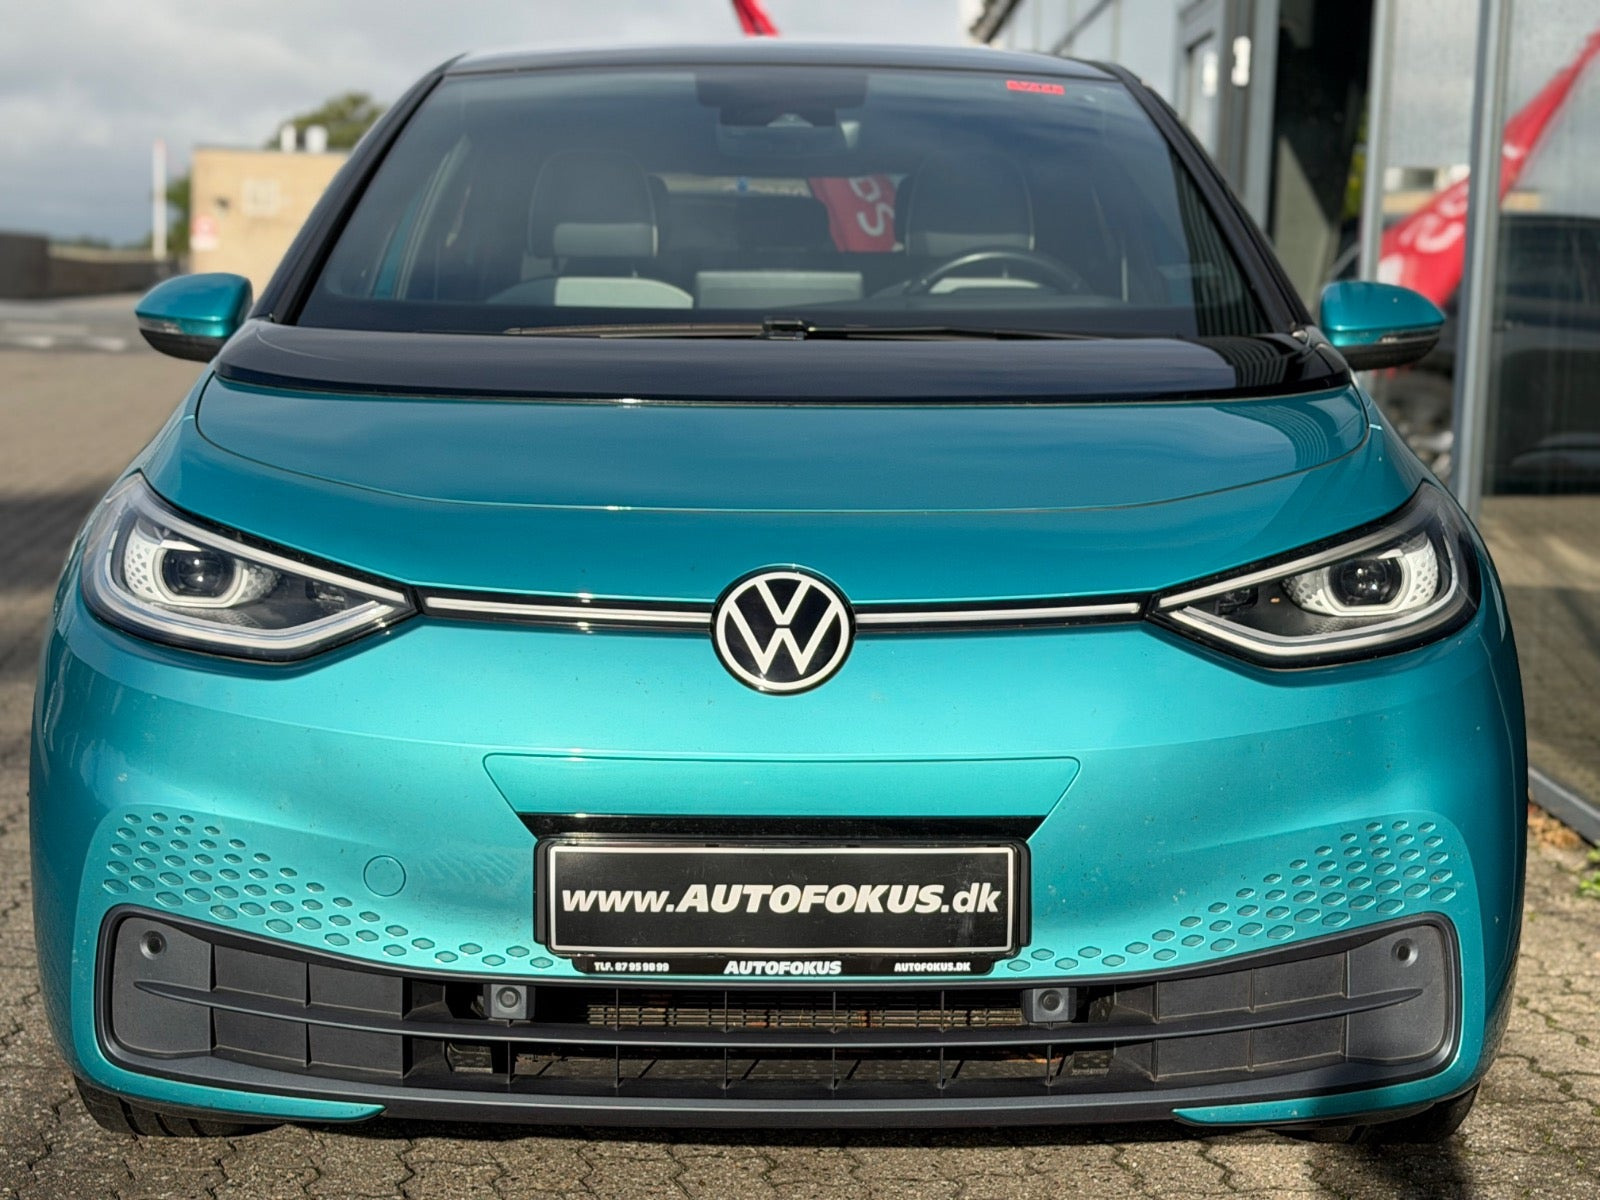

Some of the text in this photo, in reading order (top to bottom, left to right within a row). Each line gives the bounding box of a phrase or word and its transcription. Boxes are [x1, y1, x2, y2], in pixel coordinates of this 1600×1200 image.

[721, 575, 845, 680] VW
[561, 882, 1001, 913] www.AUTOFOKUS.dk
[723, 960, 842, 975] AUTOFOKUS
[894, 961, 971, 972] AUTOFOKUS.DK
